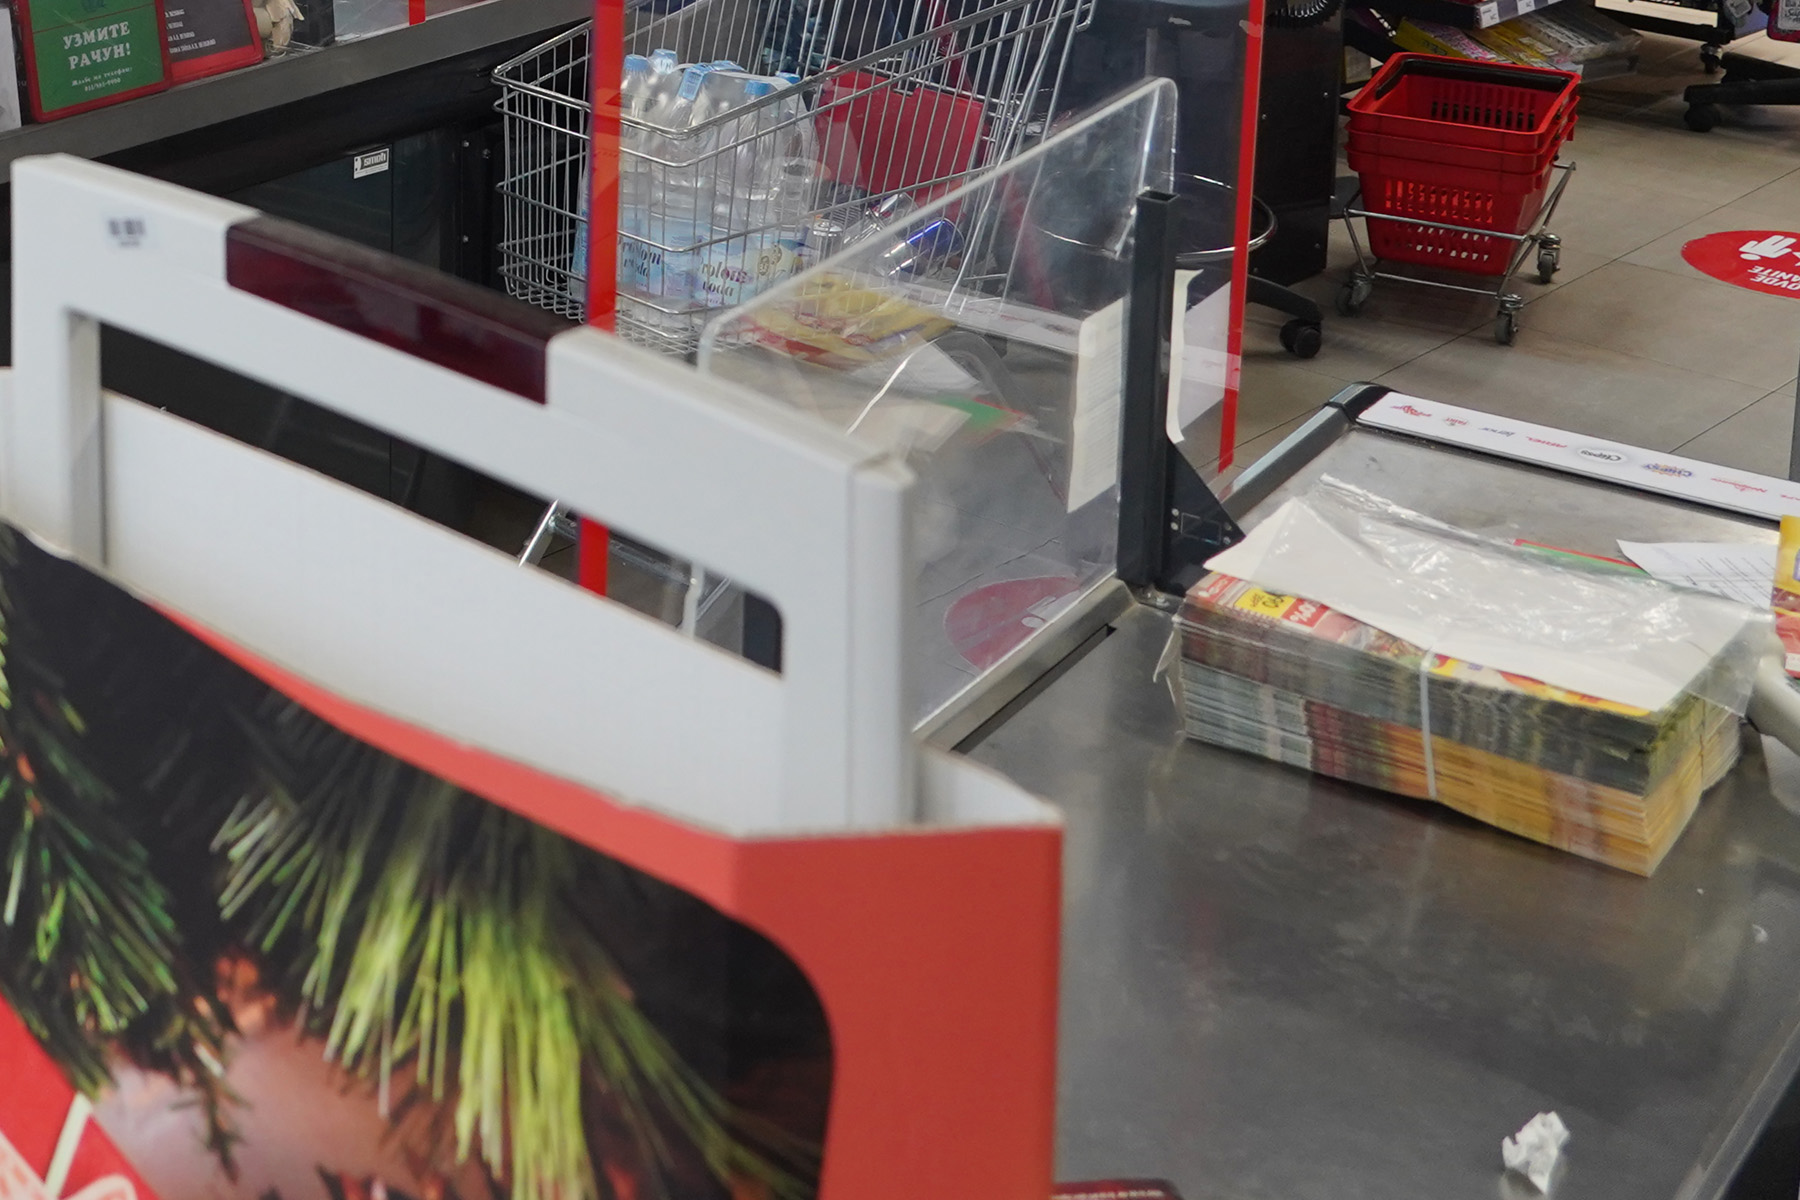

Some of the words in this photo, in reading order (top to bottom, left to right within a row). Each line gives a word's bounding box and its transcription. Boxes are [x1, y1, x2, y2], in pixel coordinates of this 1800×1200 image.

[62, 21, 131, 50] УЗМИТЕ
[67, 42, 131, 71] РАЧУН!
[1580, 447, 1622, 462] Clipsy
